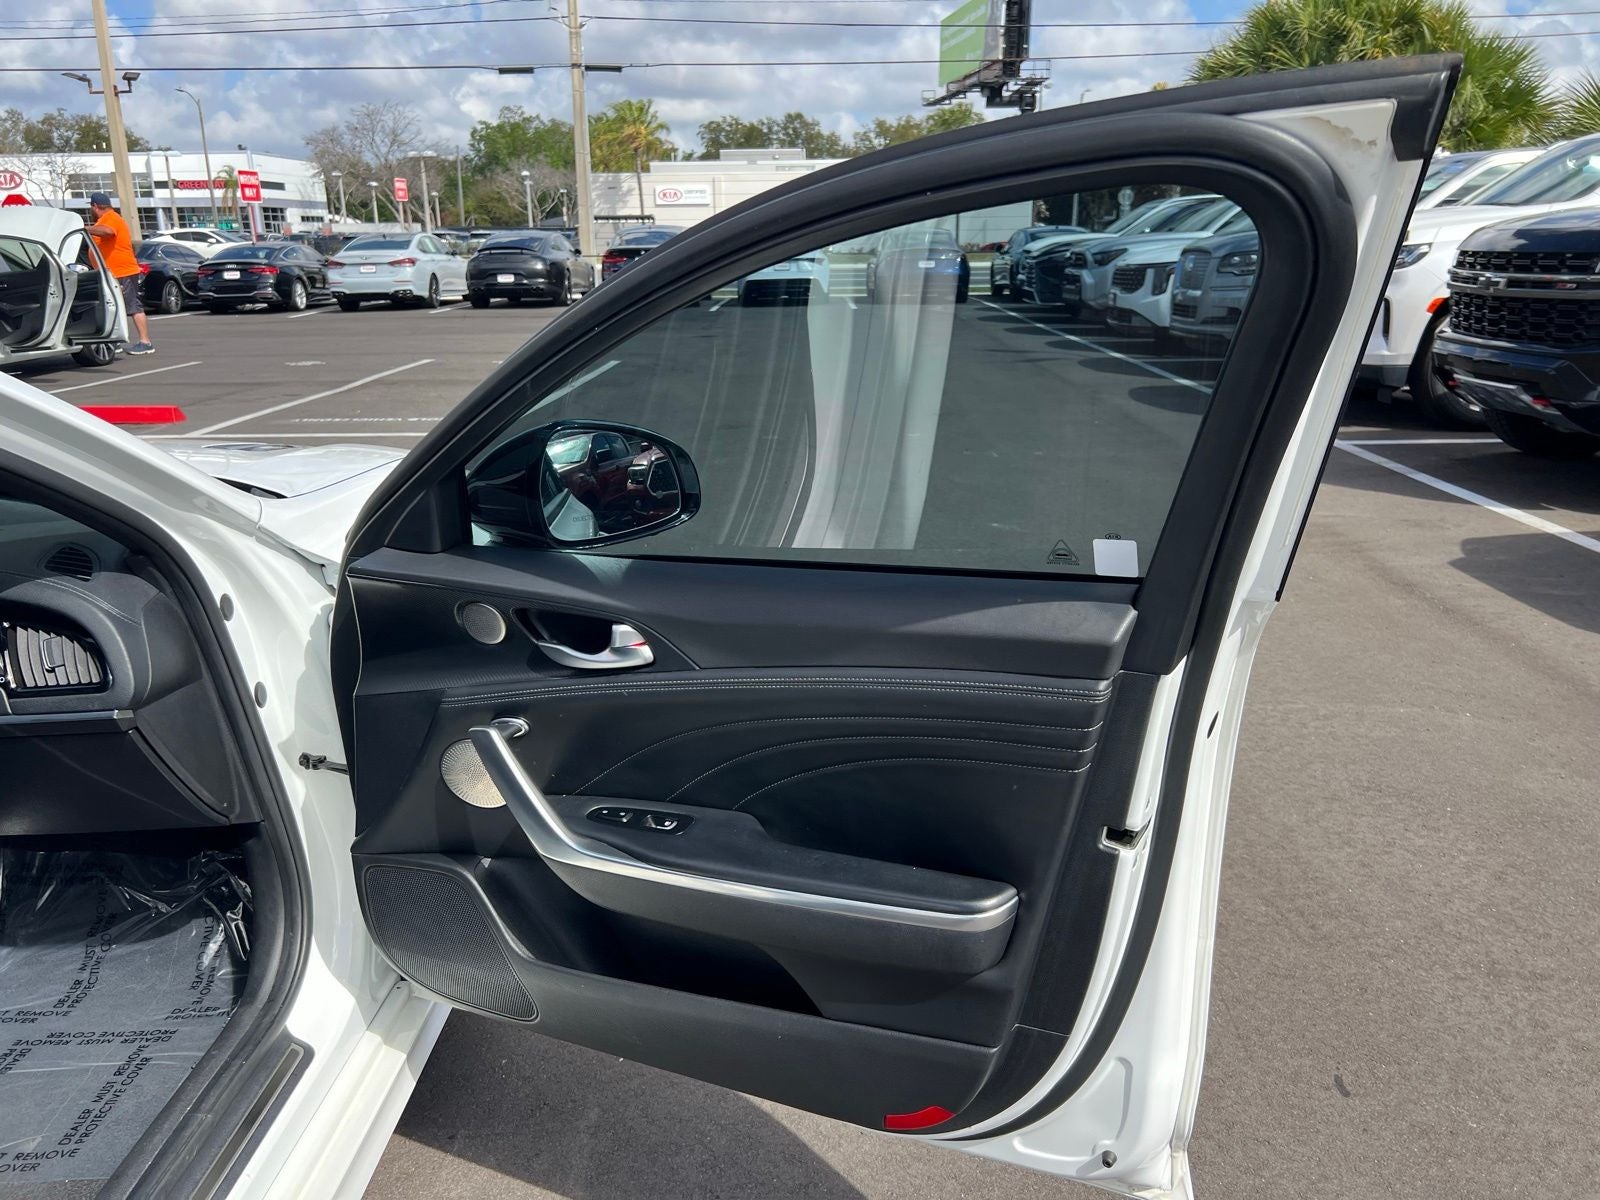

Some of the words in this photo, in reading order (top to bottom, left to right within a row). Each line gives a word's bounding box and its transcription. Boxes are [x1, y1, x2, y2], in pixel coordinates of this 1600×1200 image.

[240, 175, 259, 184] WRONG
[244, 187, 257, 197] WAY
[661, 191, 679, 200] KIA
[53, 979, 84, 1009] DEALER
[77, 944, 97, 974] MUST
[67, 954, 106, 1009] PROTECTIVE
[46, 1031, 96, 1039] COVER
[98, 1029, 180, 1038] PROTECTIVE
[12, 1039, 73, 1047] REMOVE
[76, 1038, 115, 1046] MUST
[119, 1036, 172, 1045] DEALER
[58, 1108, 96, 1145] DEALER
[91, 1080, 118, 1103] MUST
[113, 1044, 151, 1076] REMOVE
[74, 1088, 127, 1144] PROTECTIVE
[121, 1056, 154, 1086] COVER
[12, 1147, 81, 1161] REMOVE
[0, 1162, 41, 1173] OVER
